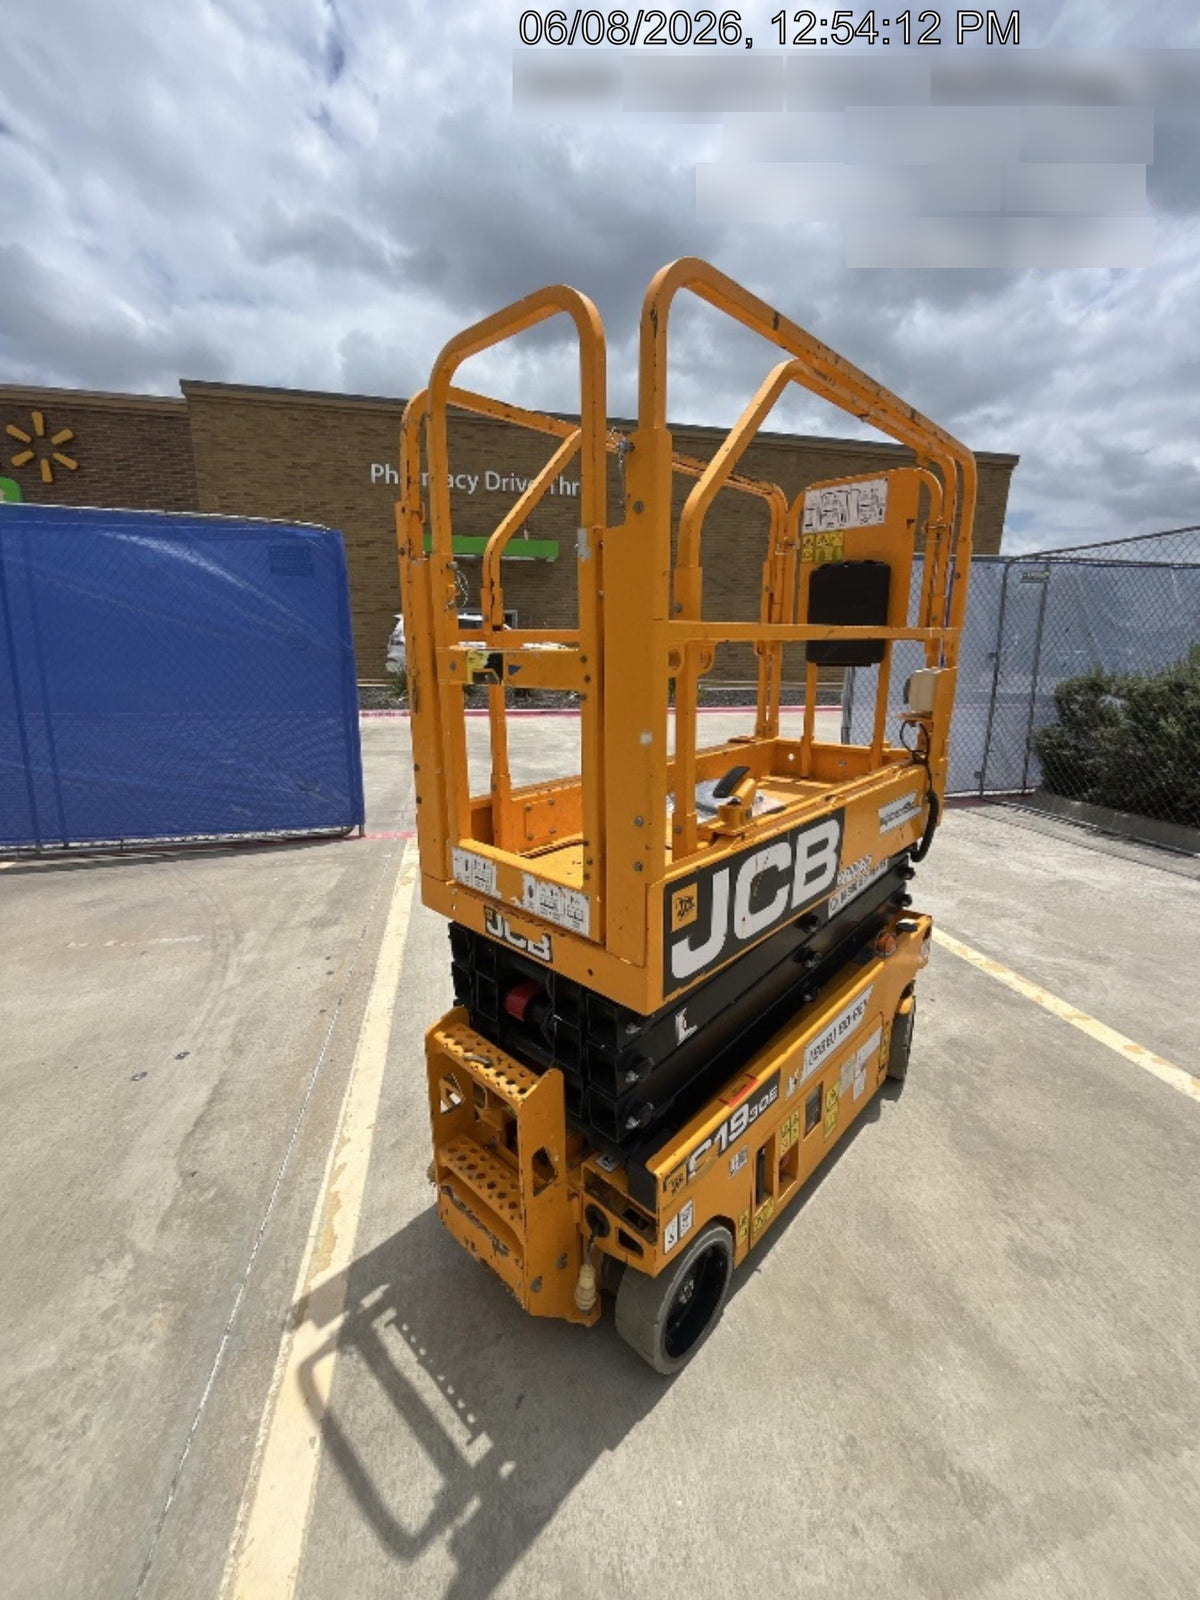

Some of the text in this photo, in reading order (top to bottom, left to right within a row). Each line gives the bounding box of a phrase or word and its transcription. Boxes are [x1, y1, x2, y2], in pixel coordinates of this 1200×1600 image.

[371, 463, 479, 495] Phacy
[485, 471, 534, 491] Driv
[671, 819, 840, 979] JCB
